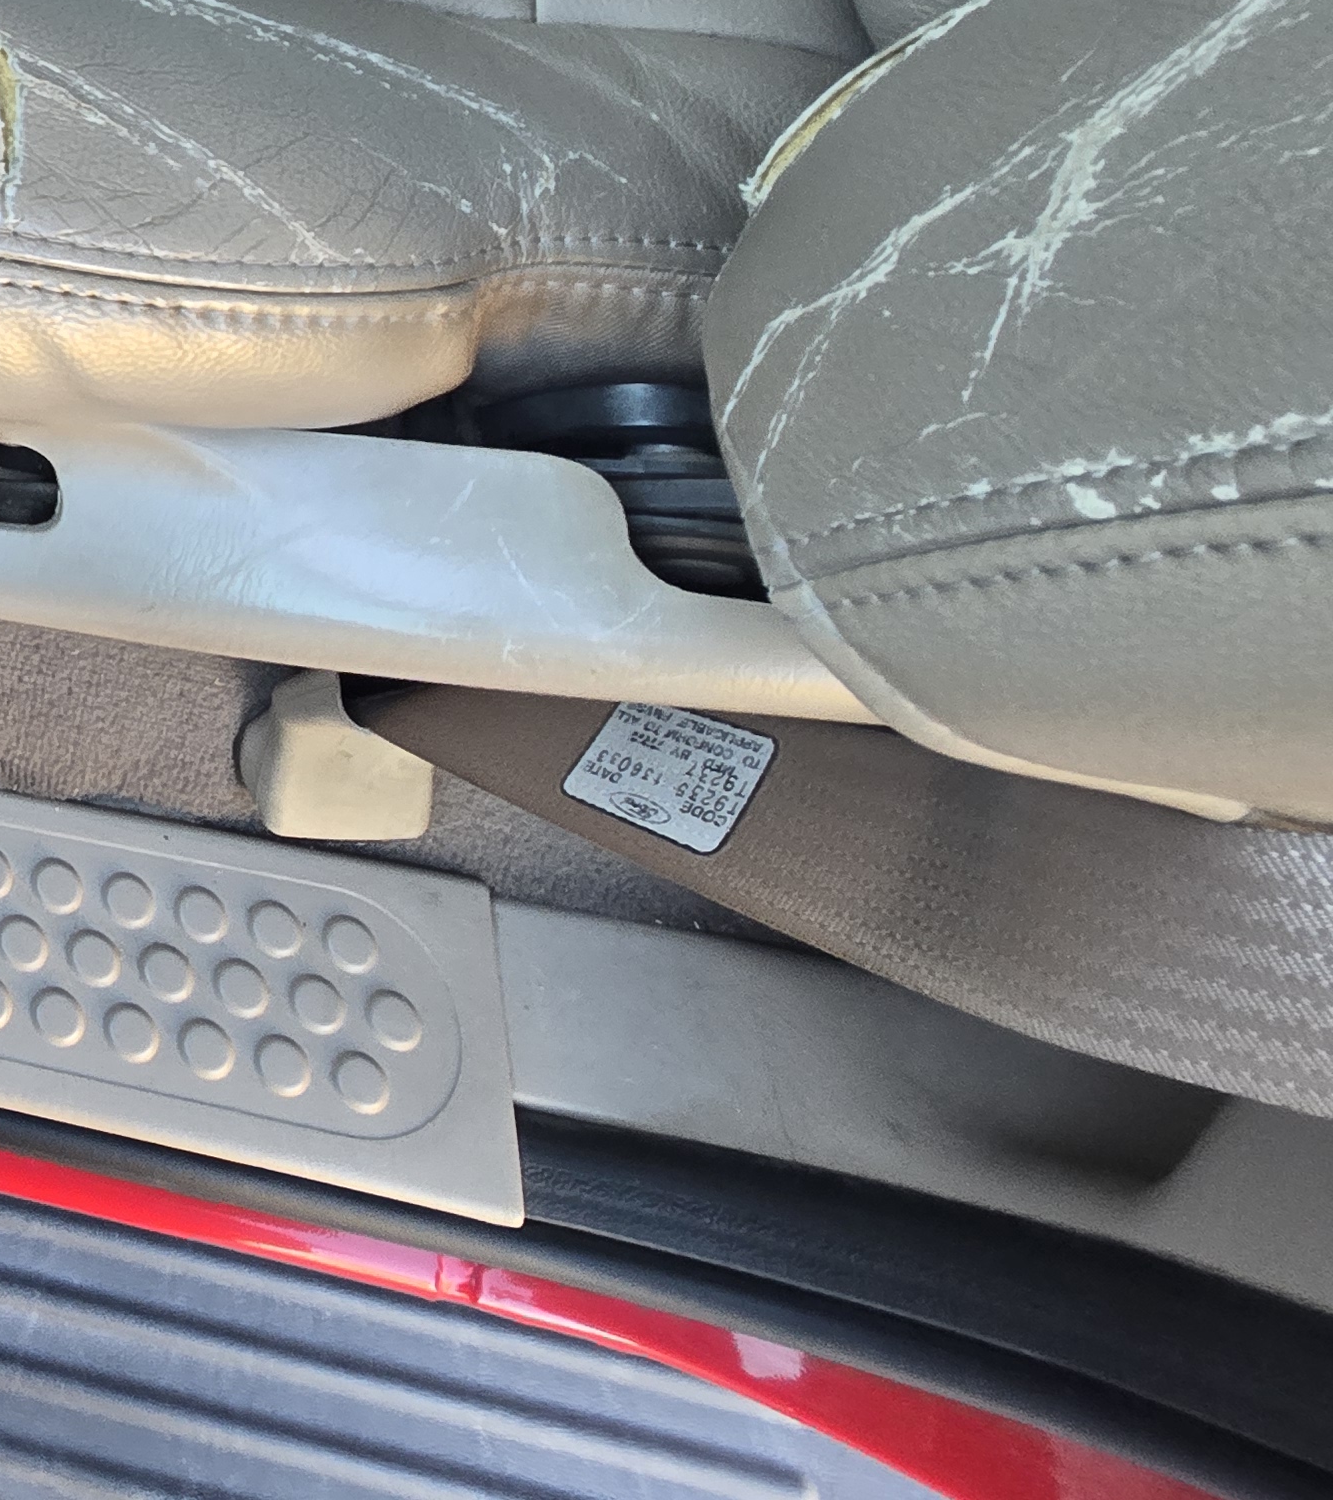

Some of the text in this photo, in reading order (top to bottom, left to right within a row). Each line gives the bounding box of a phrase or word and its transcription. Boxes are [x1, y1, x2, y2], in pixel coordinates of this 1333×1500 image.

[617, 709, 762, 770] TO CONFORM TO ALL
[675, 717, 764, 753] APPLICABLE
[669, 746, 693, 761] BY
[702, 758, 737, 777] MFD
[583, 759, 623, 784] DATE
[684, 759, 749, 799] T9237
[675, 782, 742, 816] T9235
[678, 800, 728, 827] CODE
